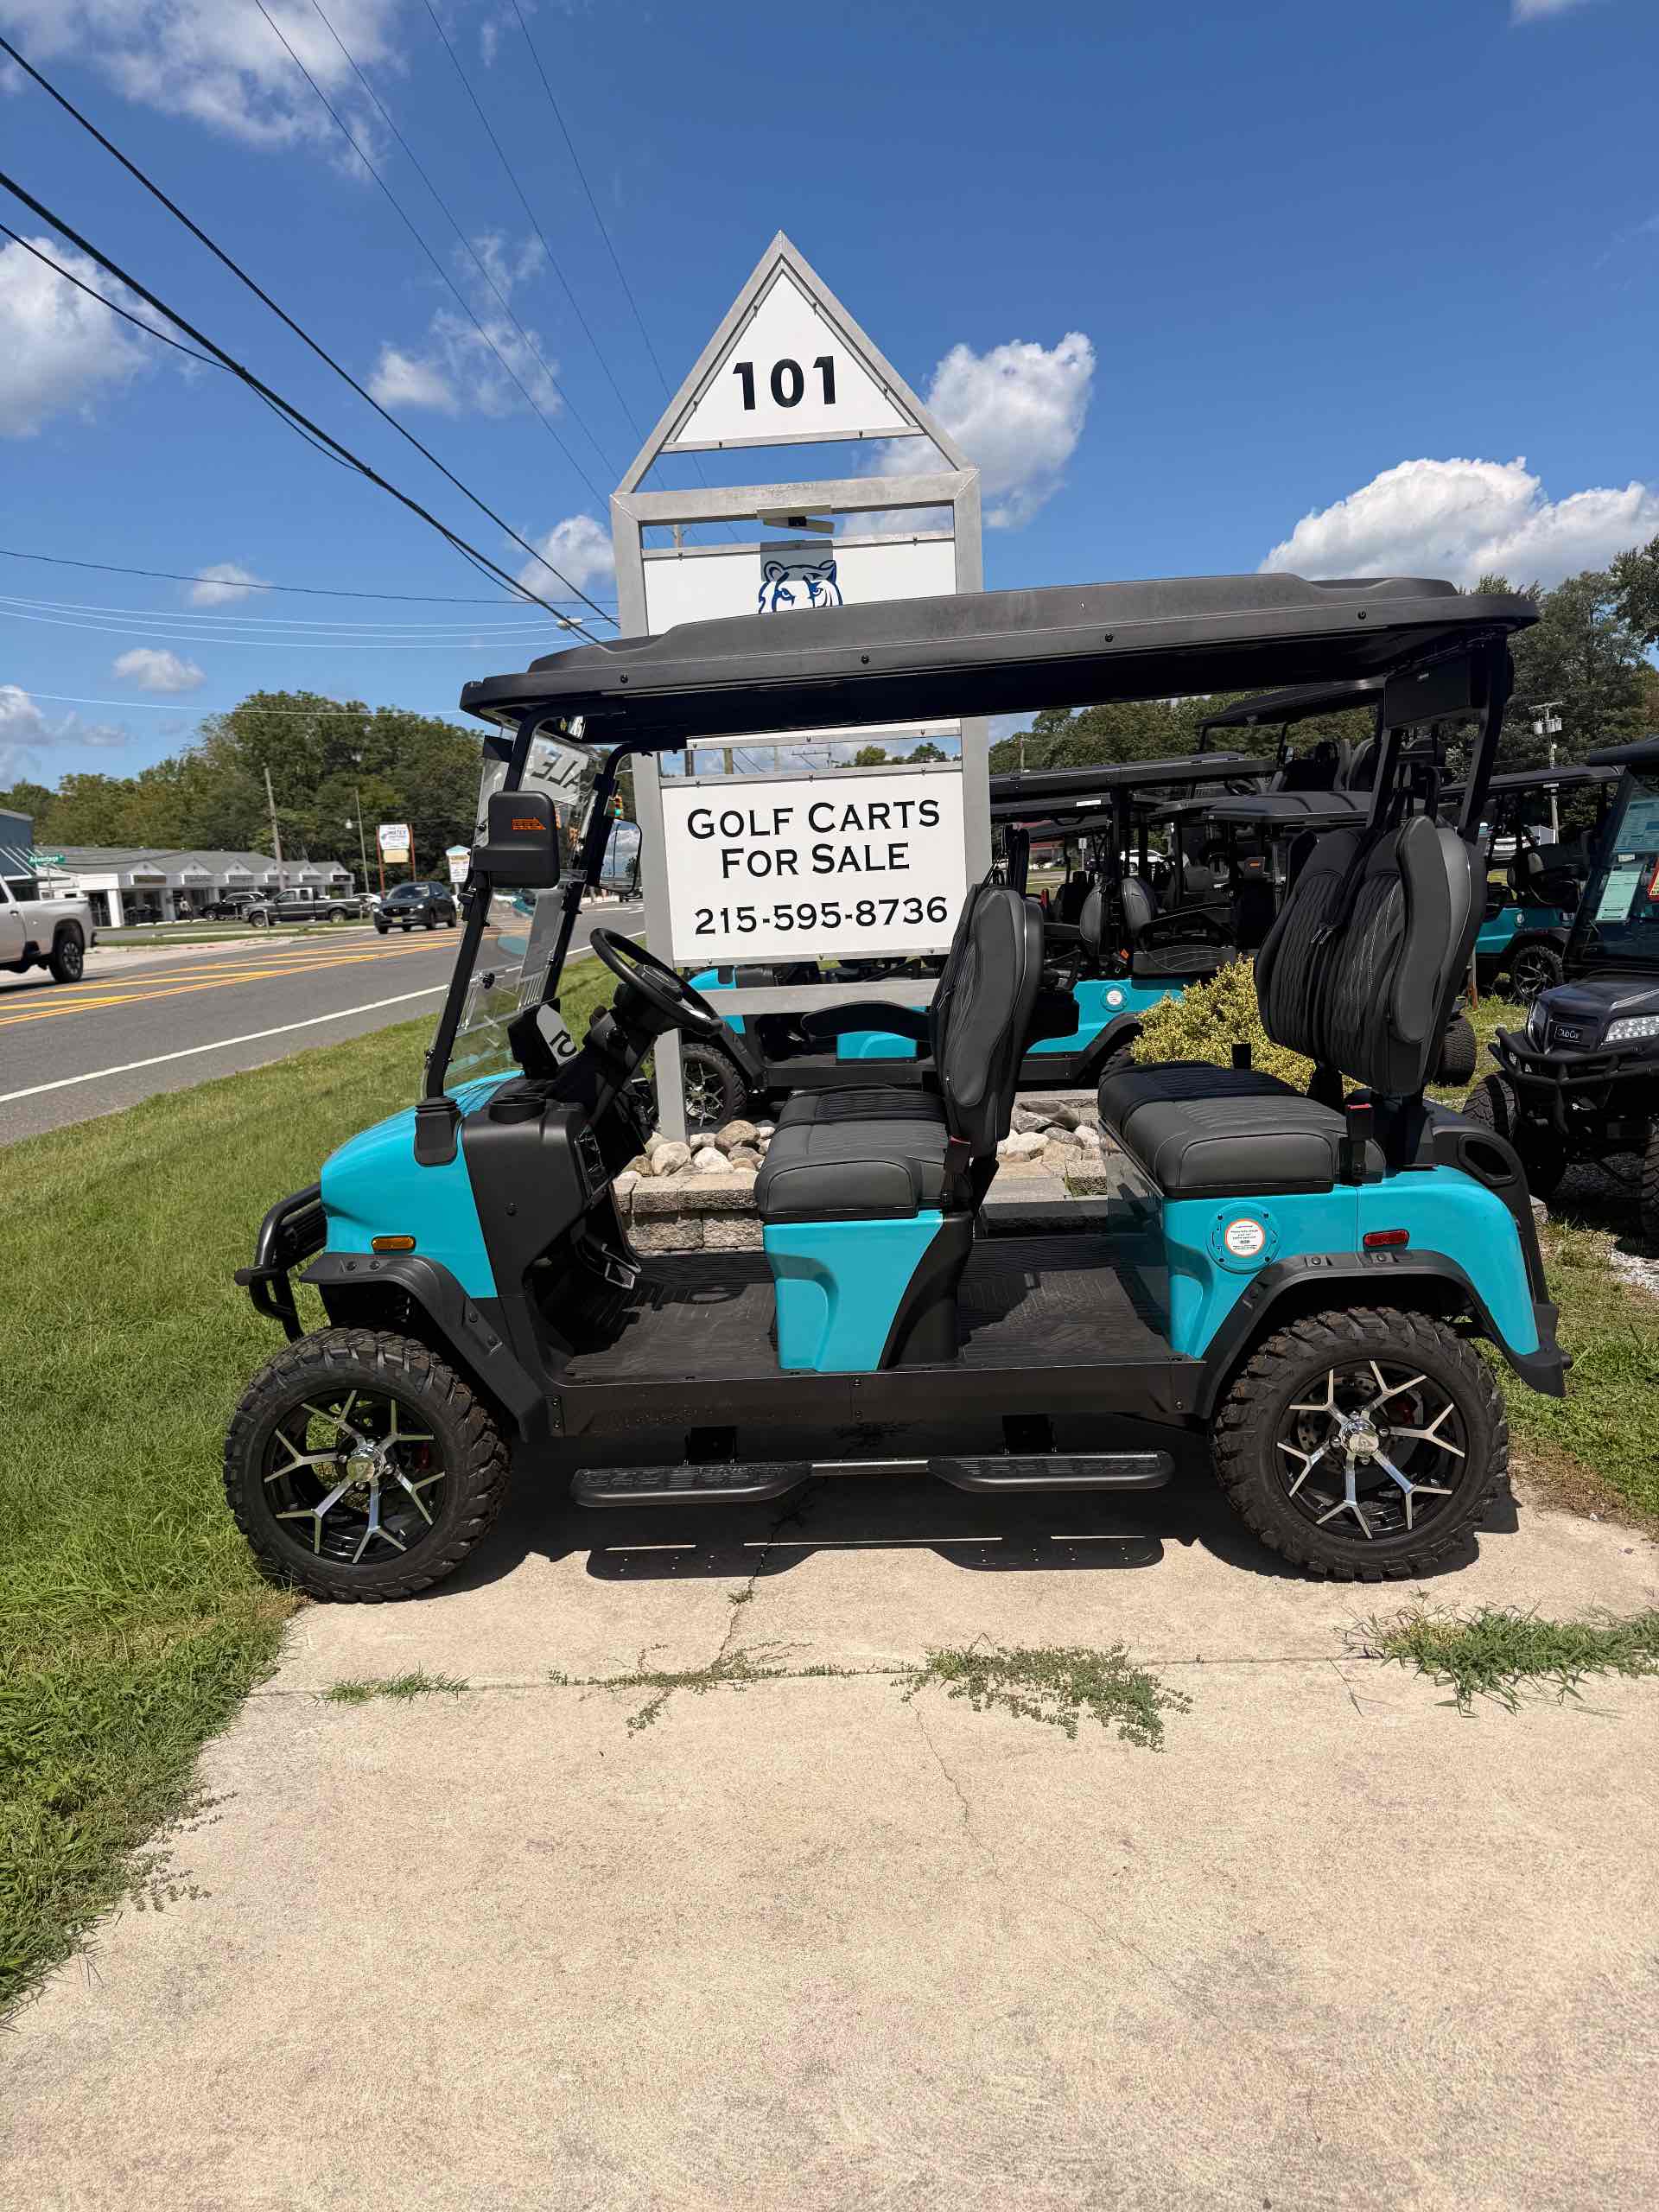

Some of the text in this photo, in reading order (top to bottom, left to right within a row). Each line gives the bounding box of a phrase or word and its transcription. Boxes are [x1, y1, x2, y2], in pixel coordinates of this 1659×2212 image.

[733, 356, 836, 410] 101
[687, 799, 940, 840] GOLF CARTS
[721, 842, 910, 879] FOR SALE
[695, 896, 948, 935] 215-595-8736
